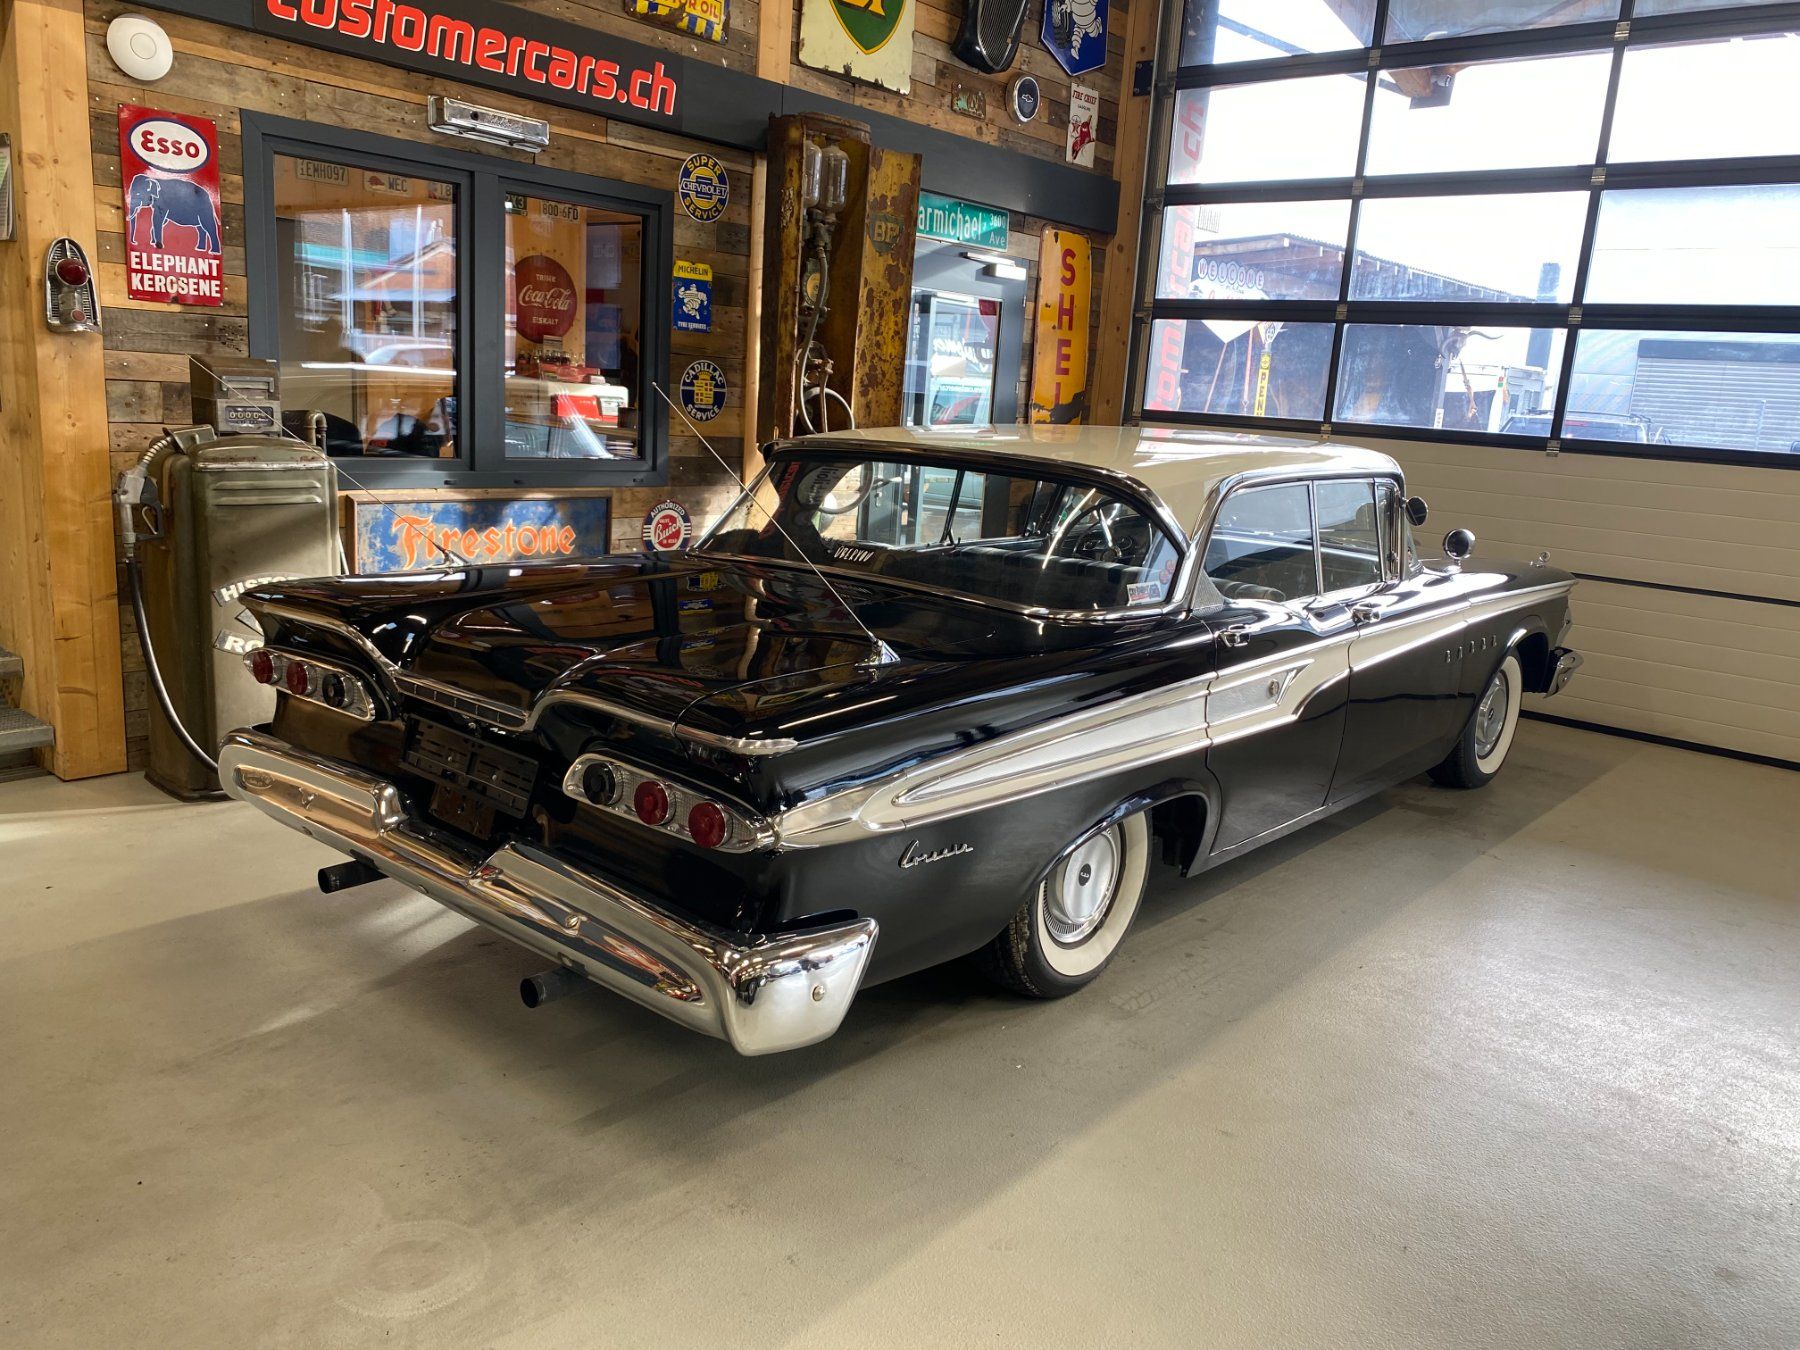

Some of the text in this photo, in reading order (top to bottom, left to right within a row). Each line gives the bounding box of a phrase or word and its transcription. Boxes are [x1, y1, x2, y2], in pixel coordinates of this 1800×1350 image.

[700, 1, 719, 19] OIL
[686, 156, 723, 176] SUPER
[681, 180, 727, 196] CHEVROLET
[683, 196, 724, 220] SERVICE
[873, 220, 900, 244] BP
[989, 231, 1006, 246] Ave
[130, 250, 220, 277] ELEPHANT
[678, 265, 709, 276] MICHELIN
[1198, 259, 1264, 289] WELCOME
[131, 272, 221, 298] KEROSENE
[518, 284, 572, 311] Coca-Cola
[532, 316, 559, 325] EISKALT
[684, 361, 725, 386] CADILLAC
[686, 403, 720, 421] SERVICE
[650, 502, 685, 518] AUTHORIZED
[391, 513, 577, 570] Firestone
[655, 517, 682, 543] Buick
